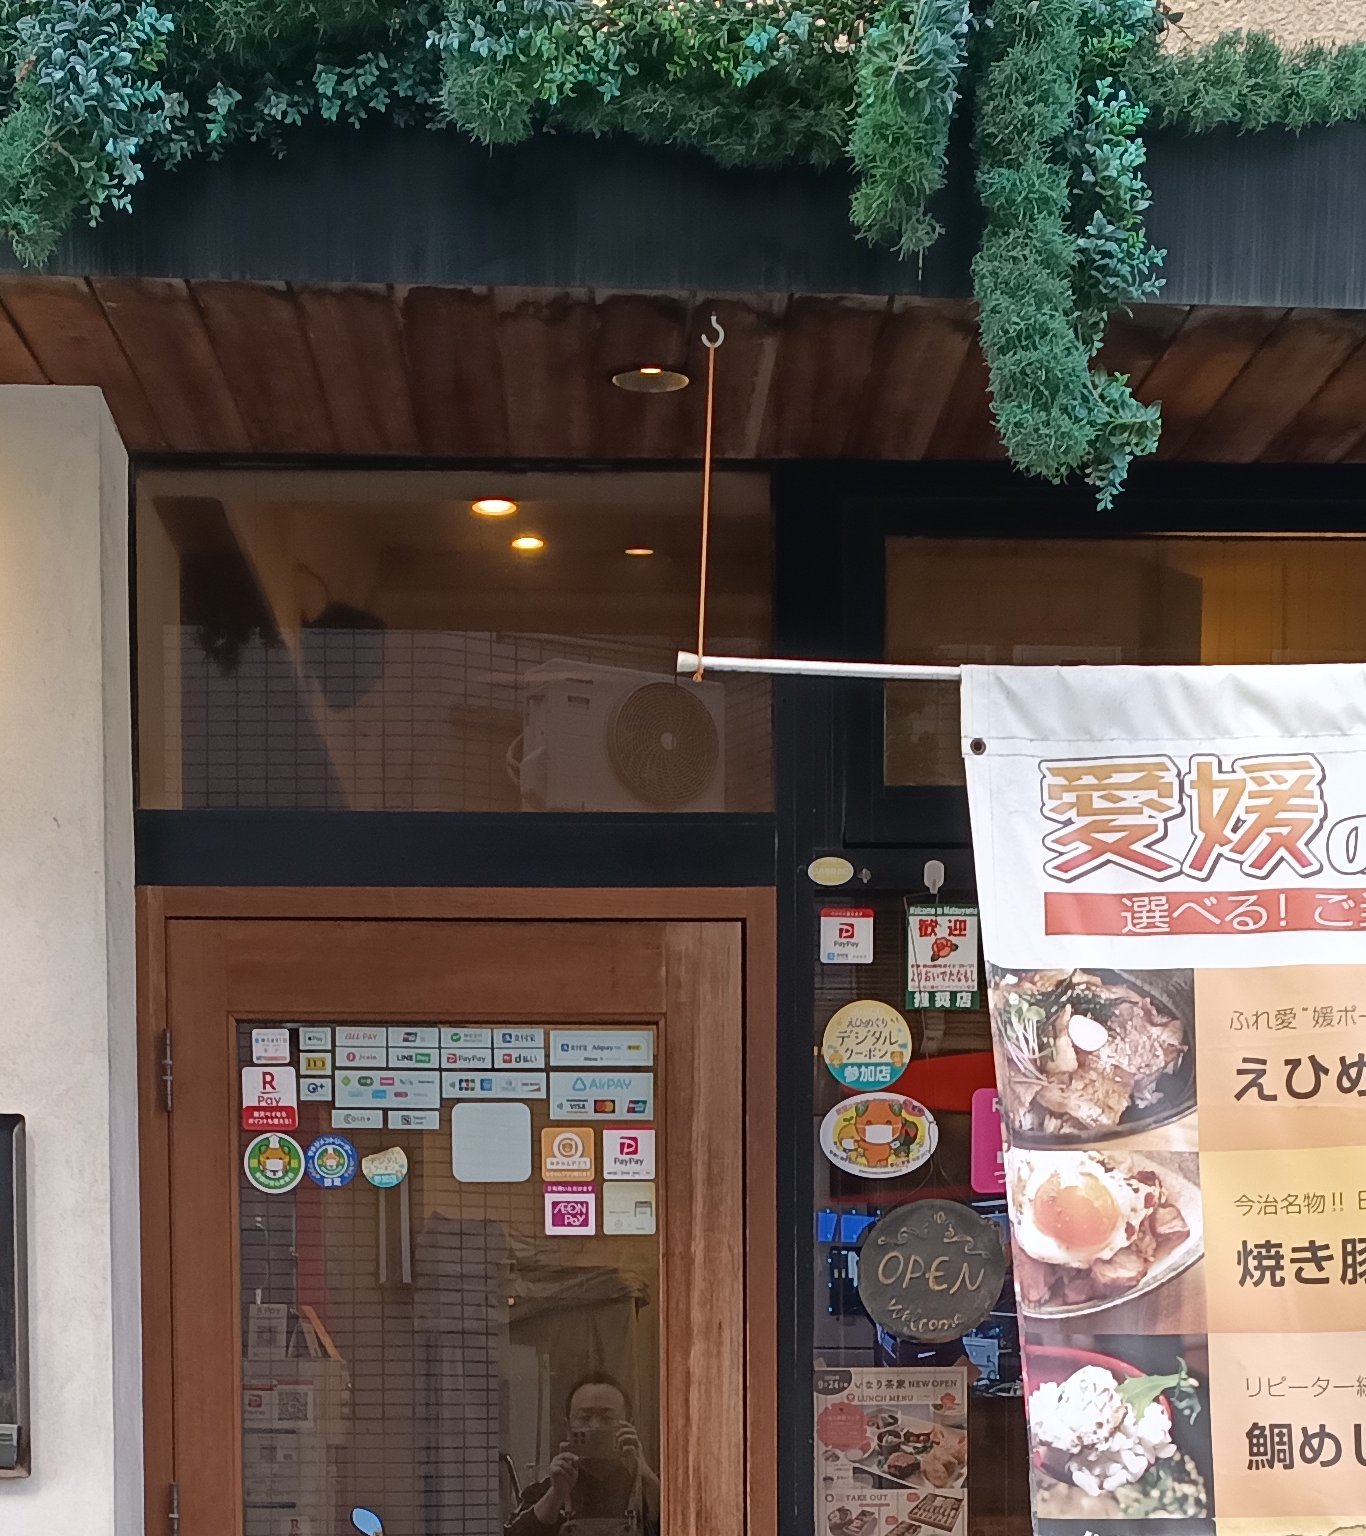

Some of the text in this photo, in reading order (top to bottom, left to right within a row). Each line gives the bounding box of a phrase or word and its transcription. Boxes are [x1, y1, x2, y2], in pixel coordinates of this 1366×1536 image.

[1121, 892, 1289, 936] 選べる！
[918, 918, 967, 938] 歓迎
[833, 940, 859, 949] PayPay
[836, 1029, 899, 1047] デジタル
[458, 1054, 486, 1063] PayPay
[843, 1047, 889, 1061] クーポン
[843, 1065, 891, 1083] 参加店
[589, 1078, 632, 1091] AirPAY
[613, 1157, 644, 1167] PayPay
[877, 1250, 985, 1294] OPEN
[908, 1379, 930, 1389] NEW
[931, 1379, 958, 1389] OPEN
